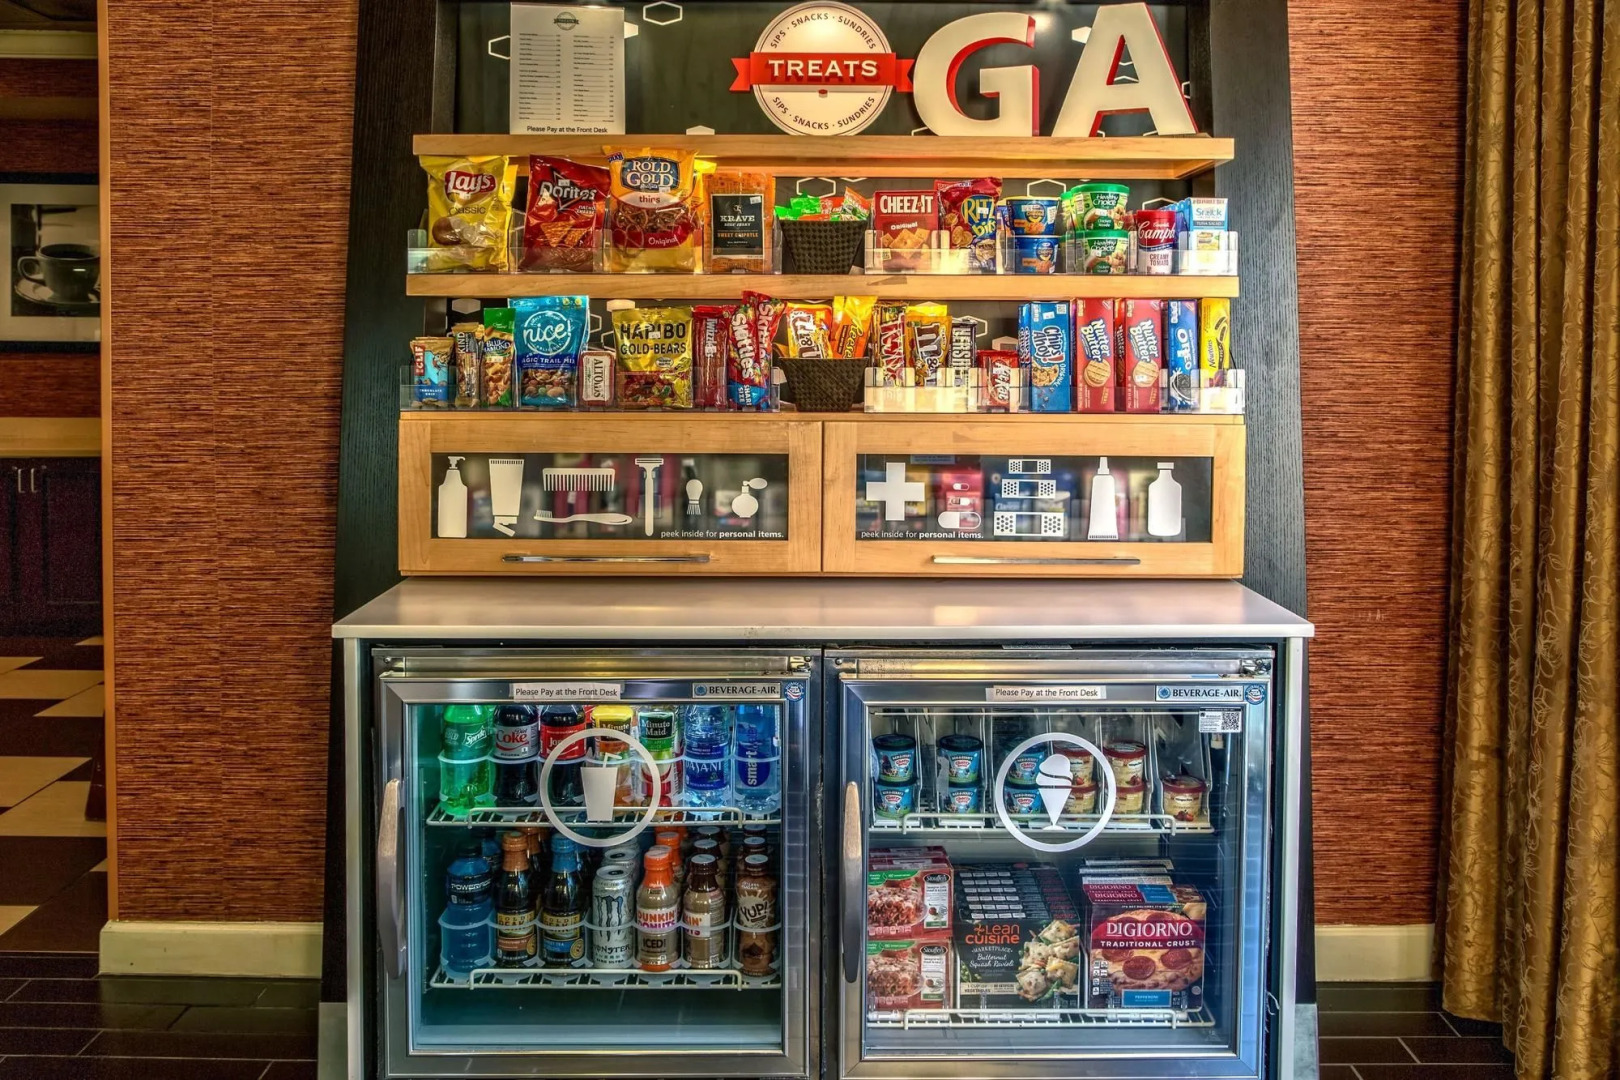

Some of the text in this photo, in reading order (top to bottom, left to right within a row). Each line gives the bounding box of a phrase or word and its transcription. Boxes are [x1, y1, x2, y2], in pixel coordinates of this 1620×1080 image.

[770, 12, 876, 49] SIPS SNACKS SUNDRIES
[768, 60, 878, 77] TREATS
[772, 96, 875, 130] SIPS SNACKS SUNDRIES
[526, 125, 546, 133] Please
[546, 125, 557, 134] Pay
[576, 126, 592, 134] Front
[593, 126, 608, 134] Desk
[632, 160, 671, 173] ROLD
[626, 171, 674, 187] GOLD
[539, 181, 598, 200] Doritos
[523, 319, 572, 343] nice!
[620, 322, 686, 340] HARIBO
[1091, 318, 1110, 357] Nutter
[1140, 319, 1158, 358] Nutter
[457, 331, 466, 353] KIND
[620, 342, 687, 355] GOLD-BEARS
[731, 313, 756, 379] Skittles
[1081, 325, 1102, 362] Butter
[1130, 326, 1150, 362] Butter
[1177, 328, 1193, 370] OREO
[414, 345, 424, 369] CLIF
[660, 530, 785, 539] peek inside for personal items.
[861, 531, 879, 539] peek
[919, 531, 956, 540] personal
[958, 531, 984, 539] items.
[515, 688, 617, 698] Please Pay at the Front Desk
[995, 688, 1098, 699] Please Pay at the Front Desk
[641, 720, 671, 728] Minute
[645, 728, 667, 736] Maid
[465, 728, 486, 745] Sprite
[496, 729, 528, 744] Coke
[686, 761, 722, 773] DASANI
[740, 900, 768, 922] YUP!
[977, 953, 1007, 961] Butternut
